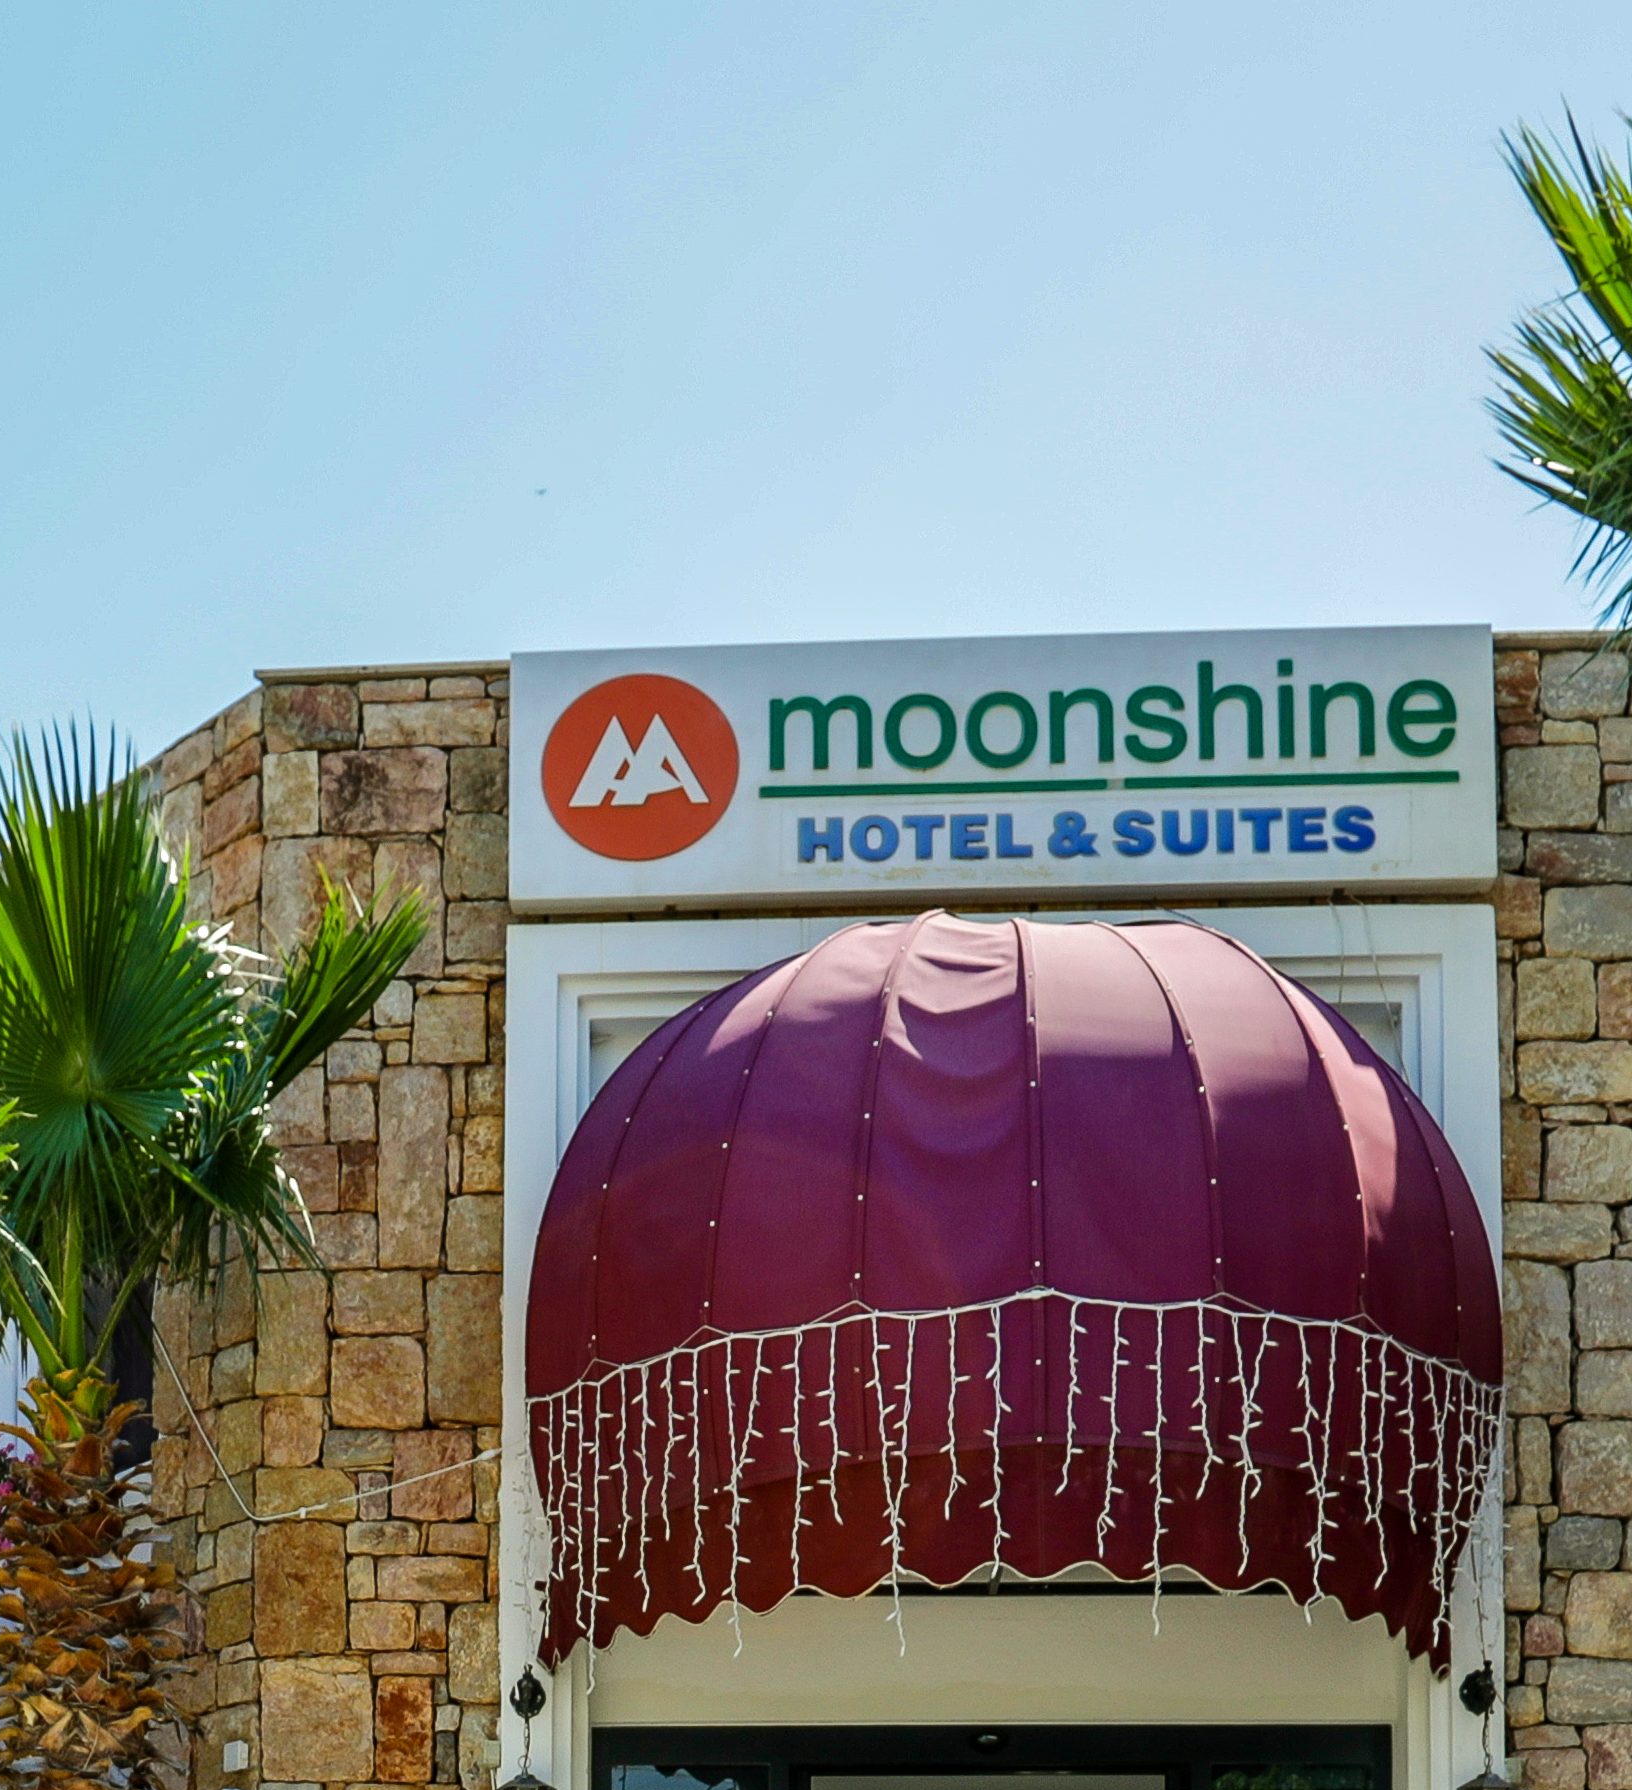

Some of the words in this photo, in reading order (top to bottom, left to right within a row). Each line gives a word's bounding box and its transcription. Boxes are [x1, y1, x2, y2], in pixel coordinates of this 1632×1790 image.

[768, 657, 1458, 770] moonshine
[799, 813, 1032, 862] HOTEL
[1049, 810, 1099, 858] &
[1113, 805, 1376, 856] SUITES
